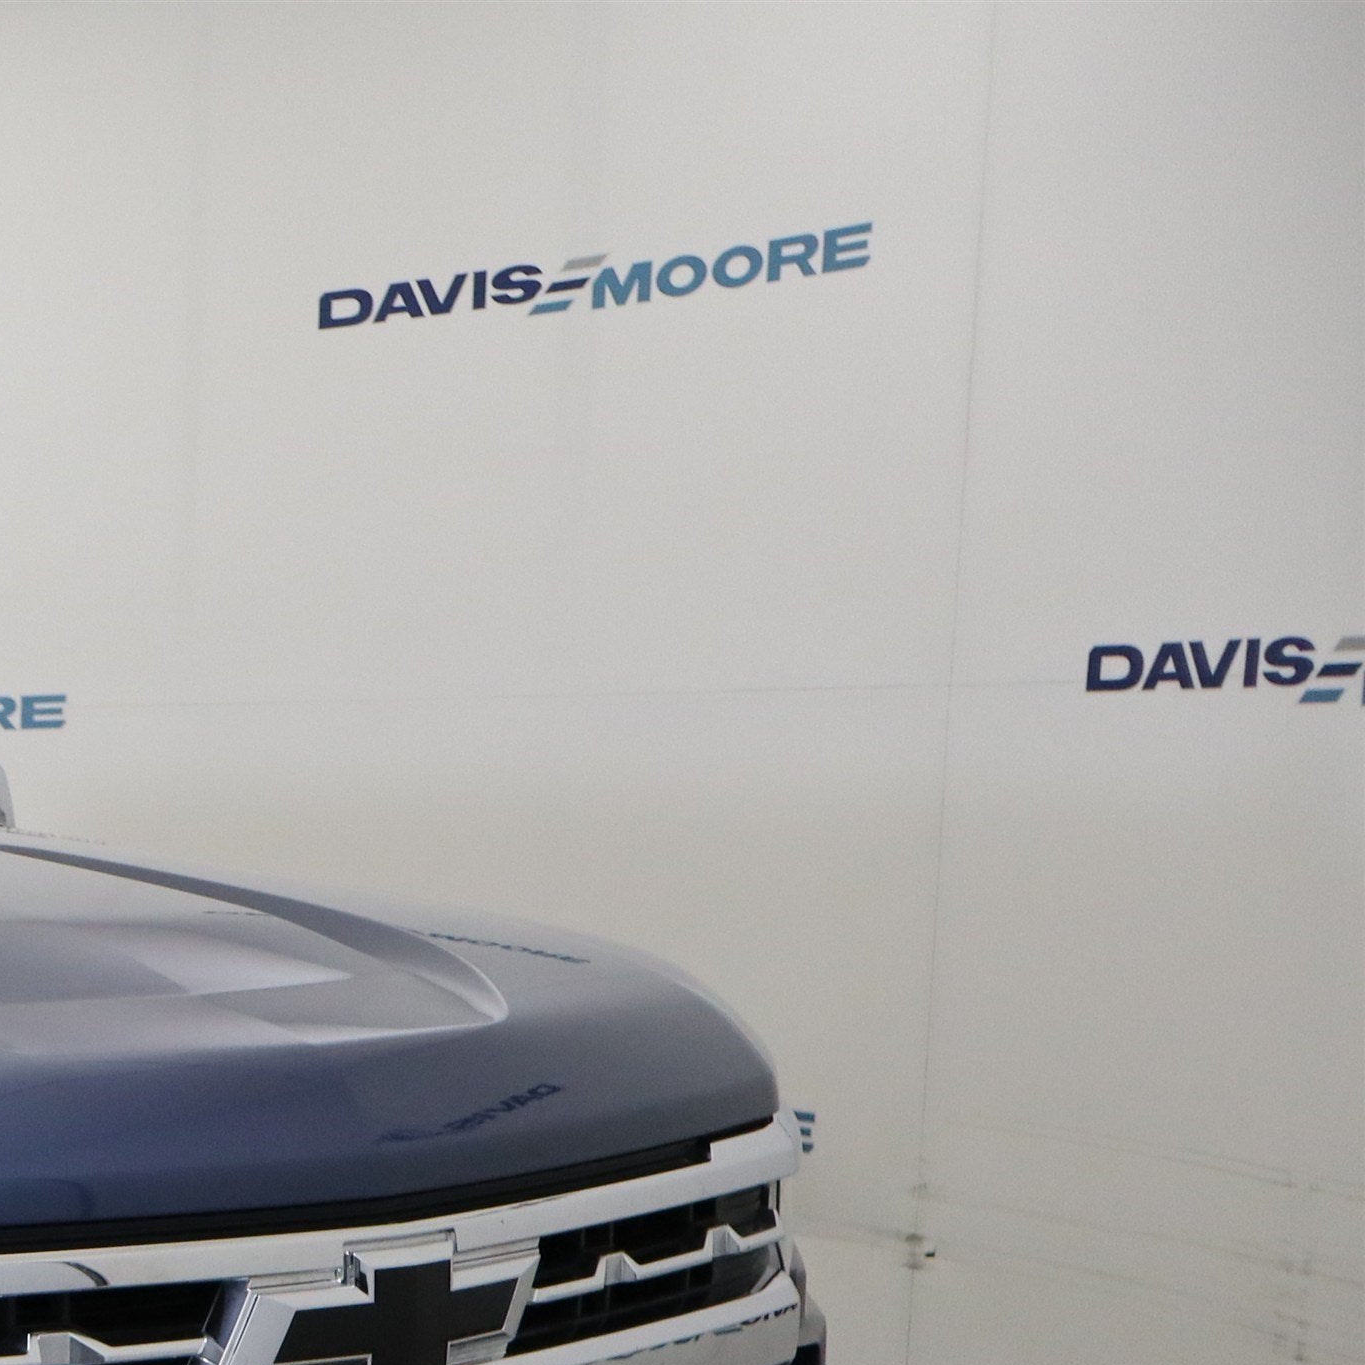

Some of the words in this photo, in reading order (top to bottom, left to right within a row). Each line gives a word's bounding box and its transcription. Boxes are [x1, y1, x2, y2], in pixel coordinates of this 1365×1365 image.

[318, 265, 543, 331] DAVIS
[592, 223, 873, 310] MOORE
[1085, 636, 1316, 693] DAVIS
